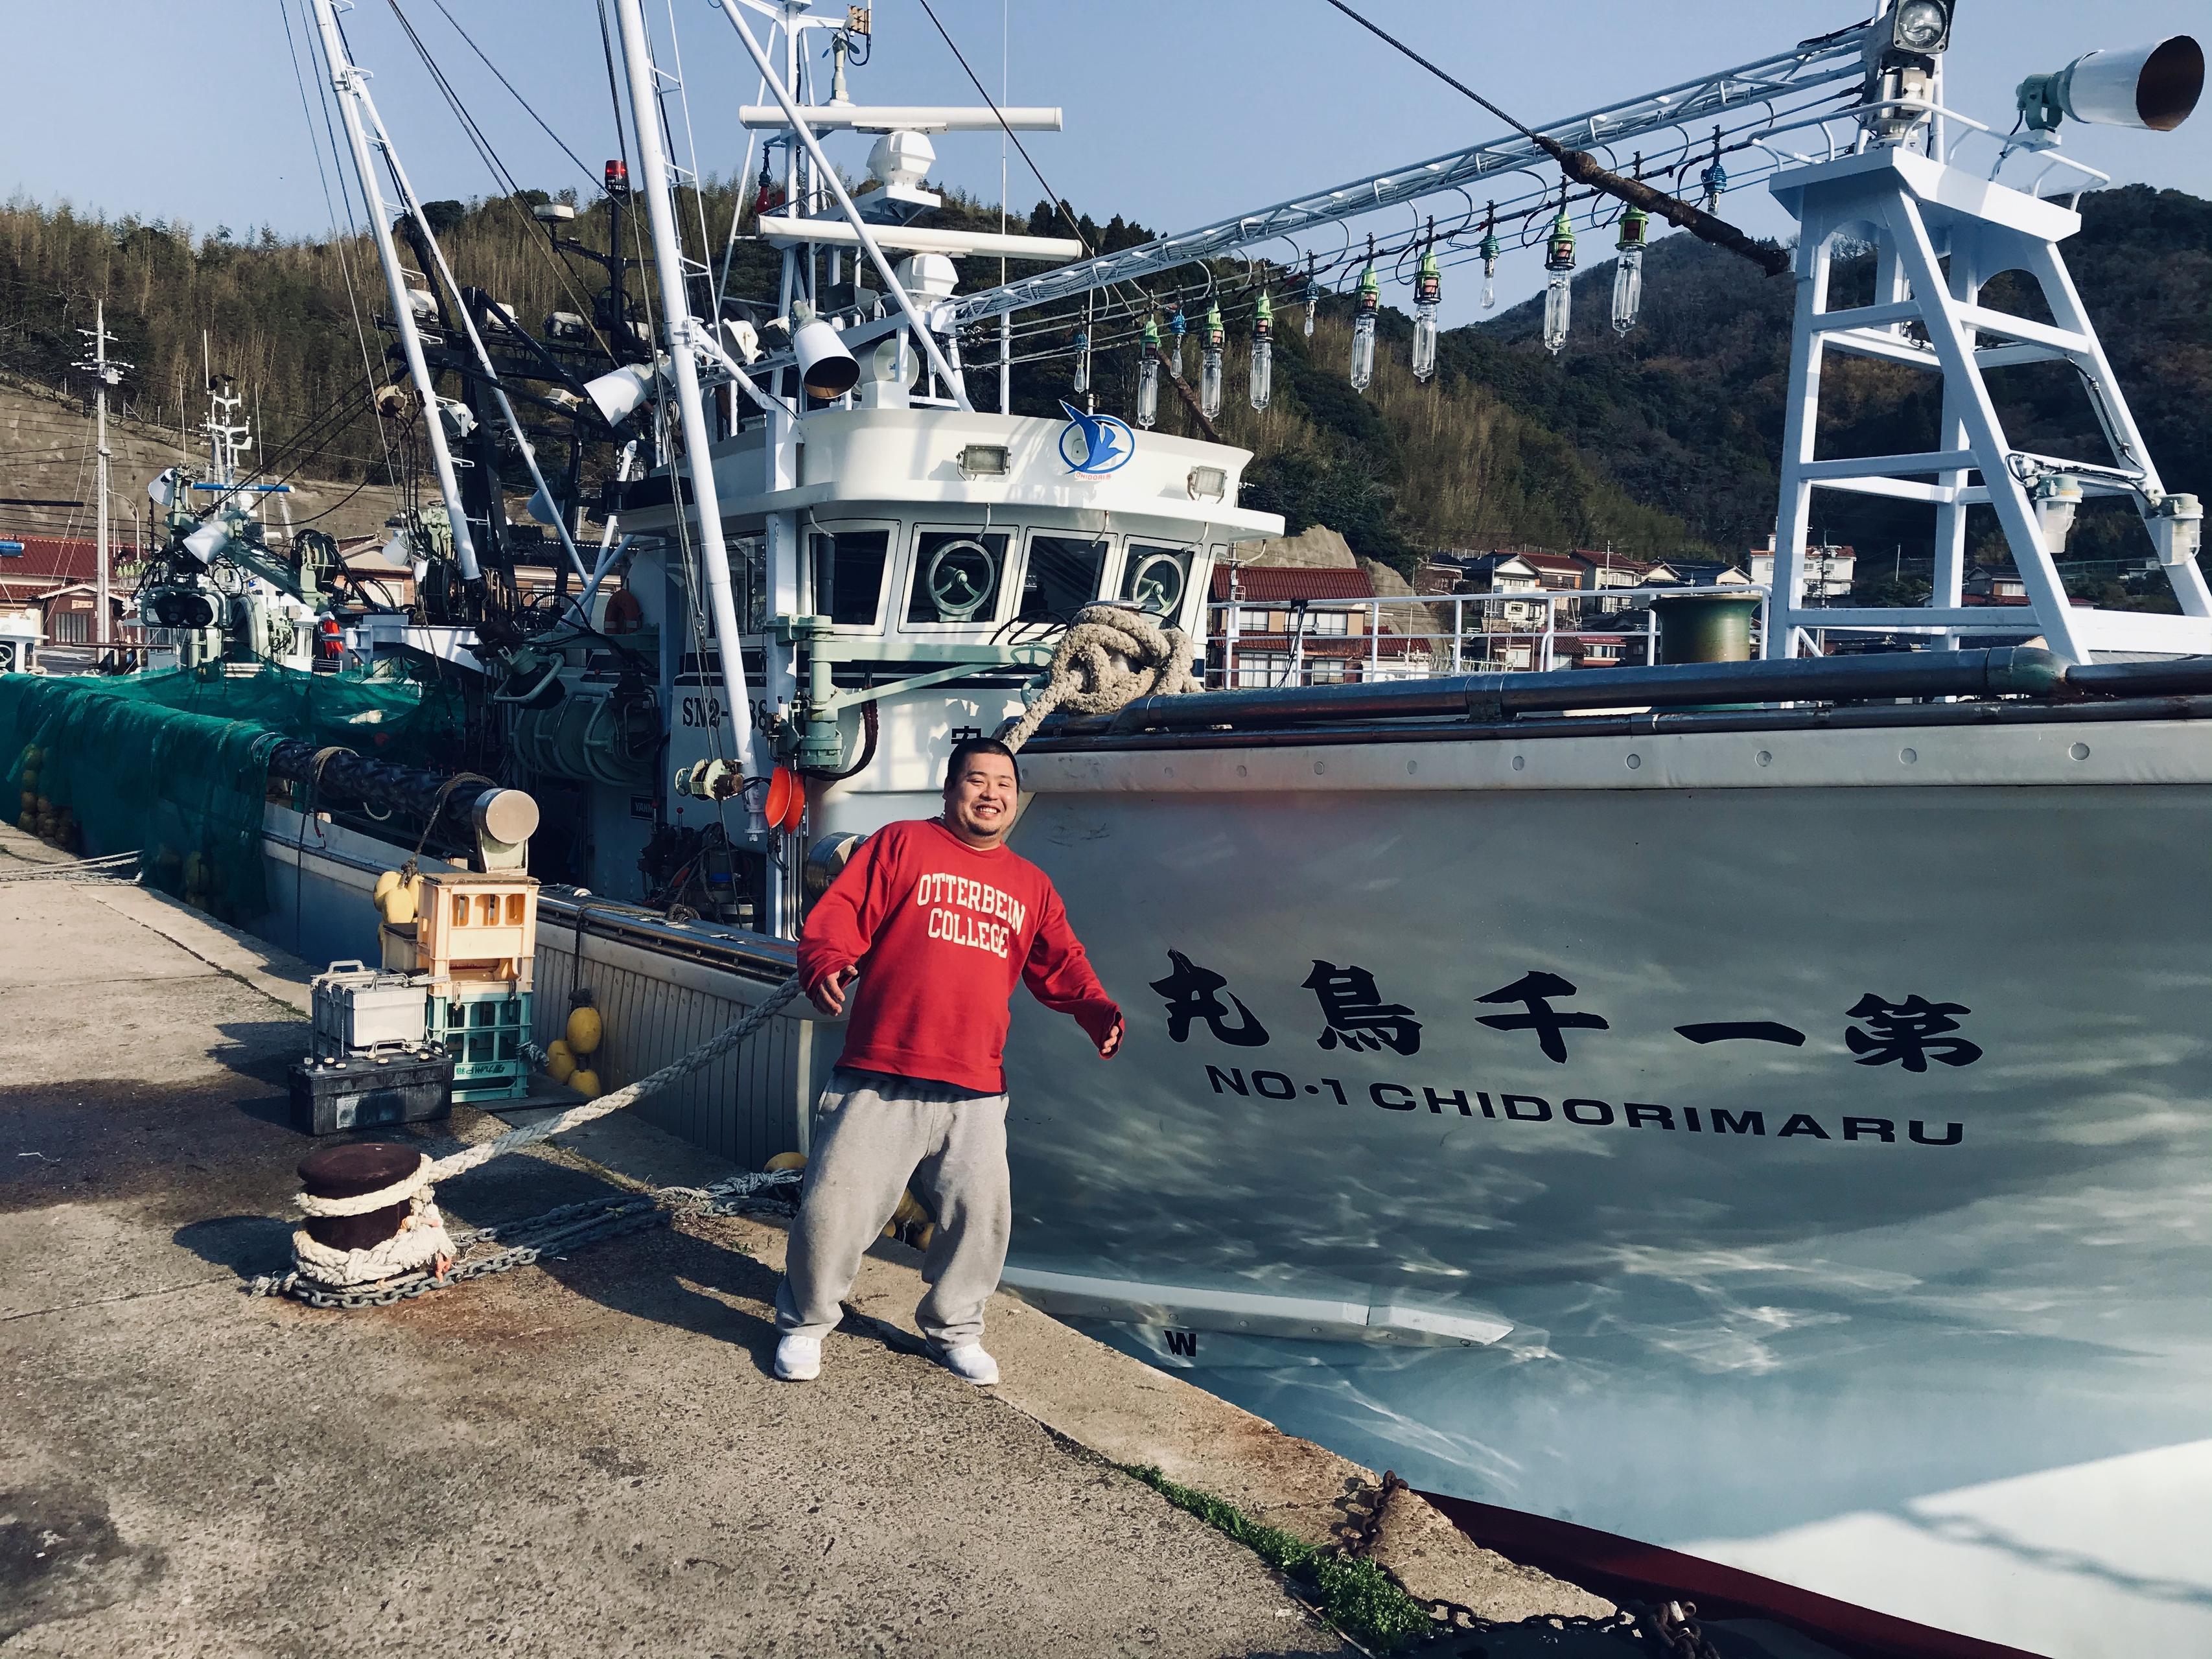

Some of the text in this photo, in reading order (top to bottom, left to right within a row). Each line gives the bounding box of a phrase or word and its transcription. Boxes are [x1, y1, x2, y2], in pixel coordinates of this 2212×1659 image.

[916, 872, 1026, 936] OTTERBEIN
[927, 907, 1010, 959] COLLEGE
[1369, 1082, 1964, 1146] CHIDORIMARU
[1163, 1330, 1197, 1357] W
